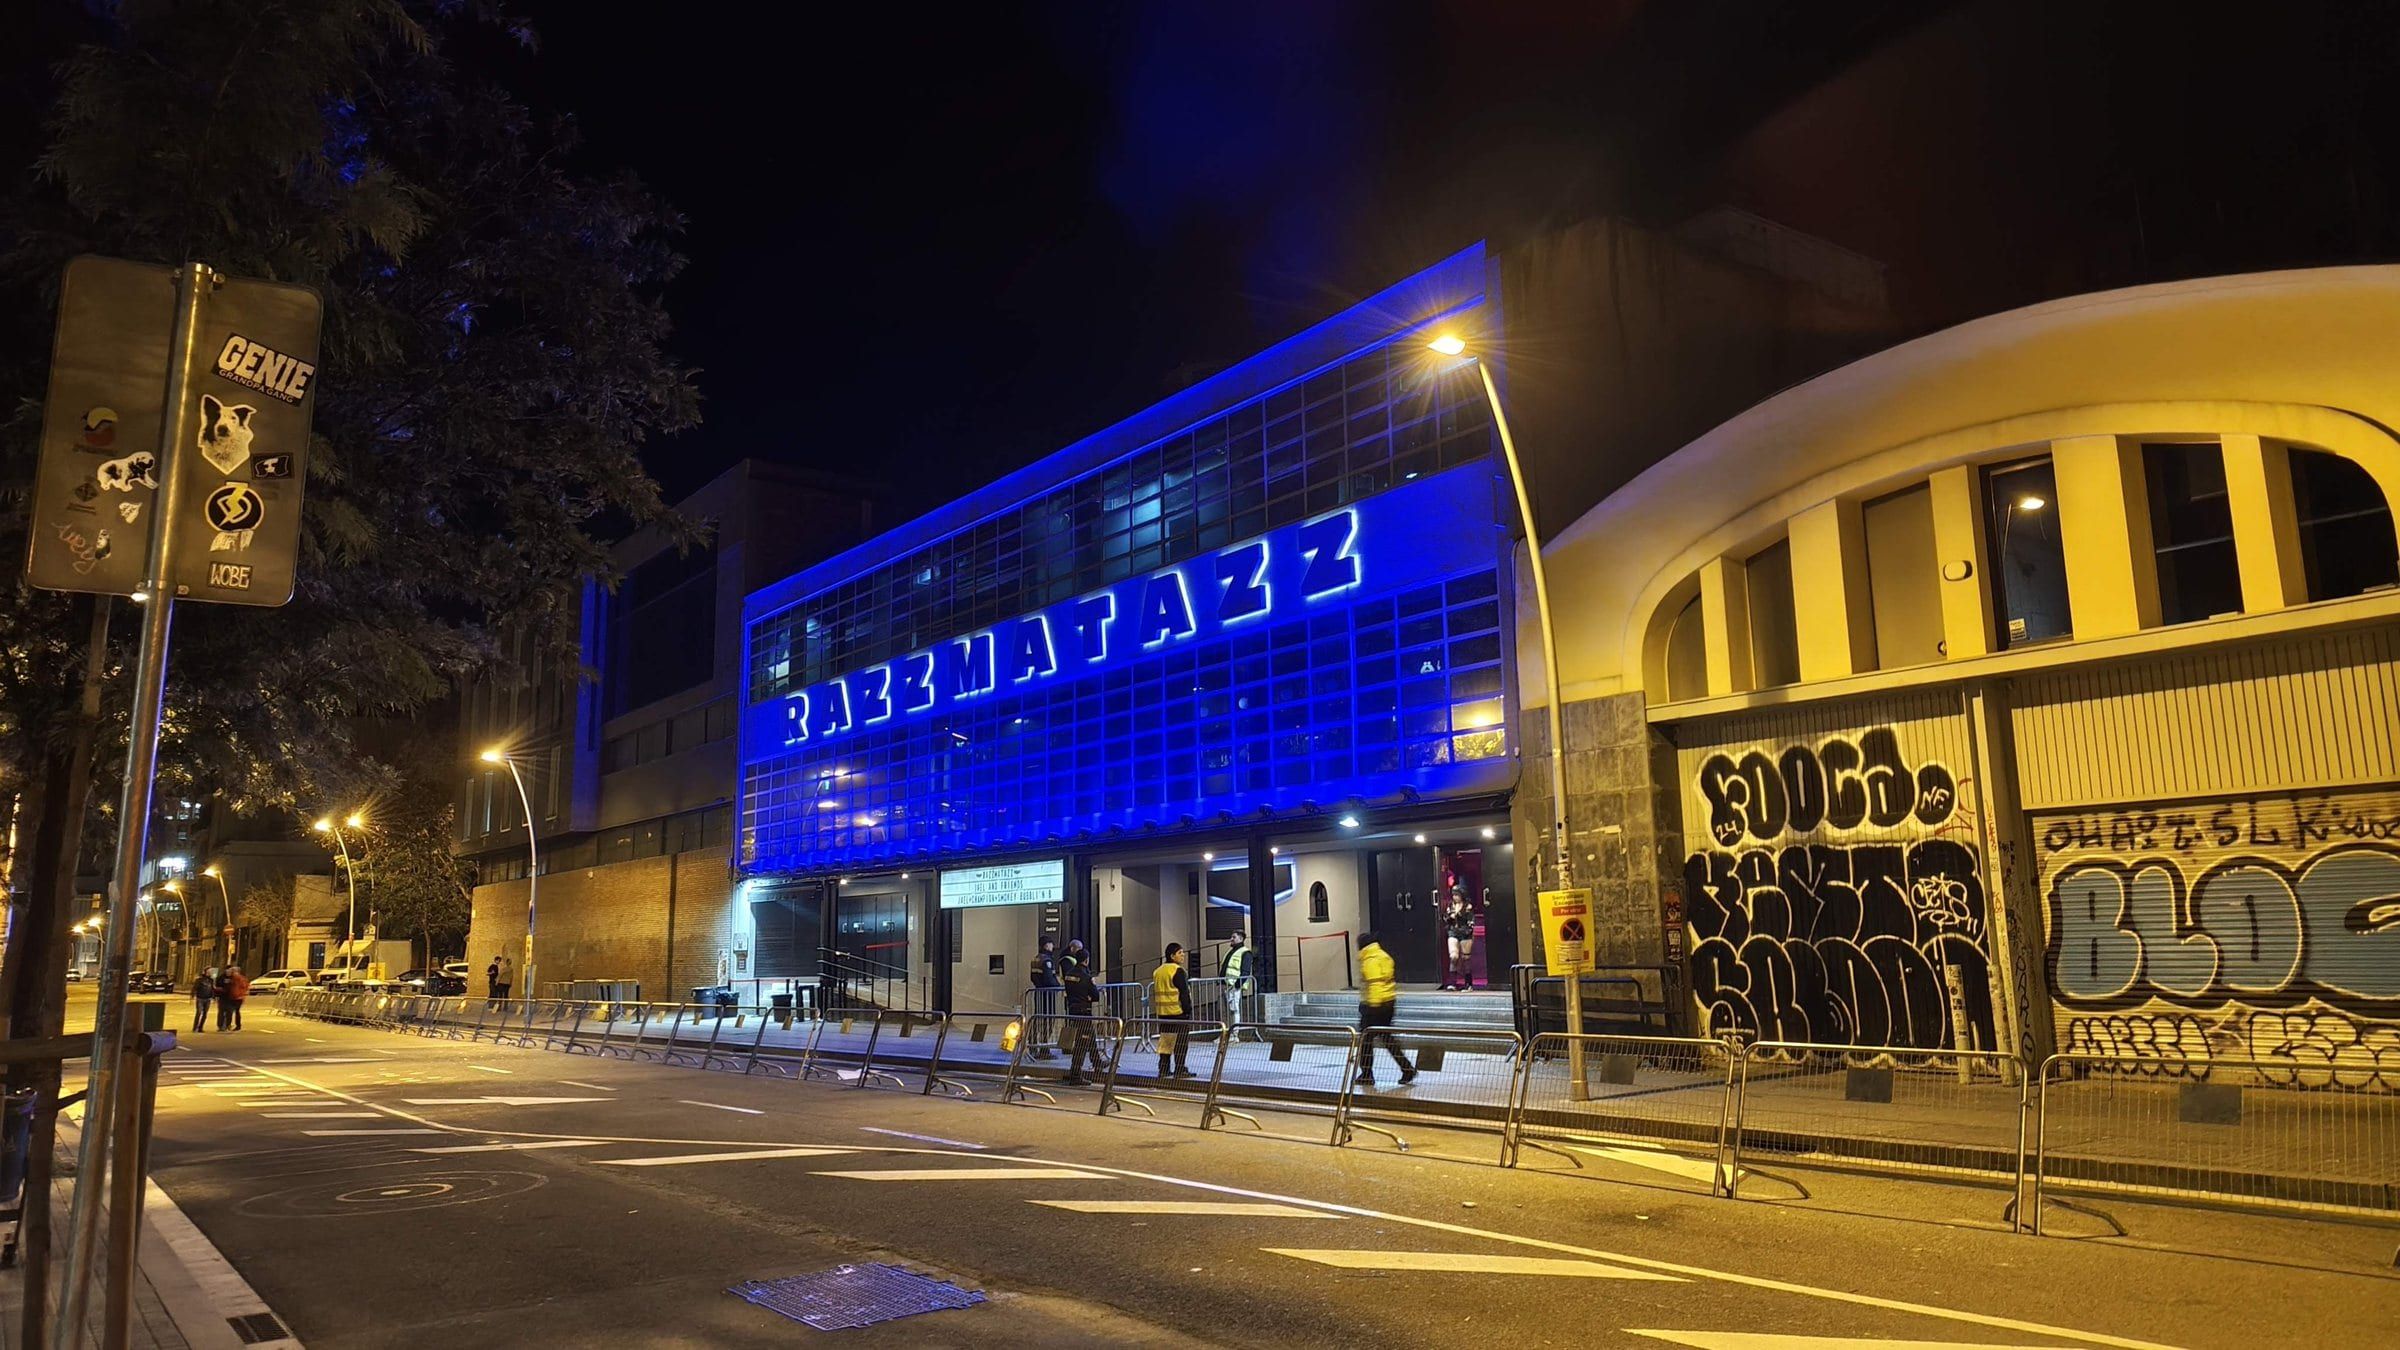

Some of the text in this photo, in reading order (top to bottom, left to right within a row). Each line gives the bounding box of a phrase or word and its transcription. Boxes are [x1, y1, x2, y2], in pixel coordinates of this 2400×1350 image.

[217, 335, 315, 399] GENIE
[218, 369, 294, 403] GRANDPA GANG
[783, 509, 1362, 746] RAZZMATAZZ
[988, 881, 998, 891] AND
[1000, 879, 1024, 890] FRIENDS
